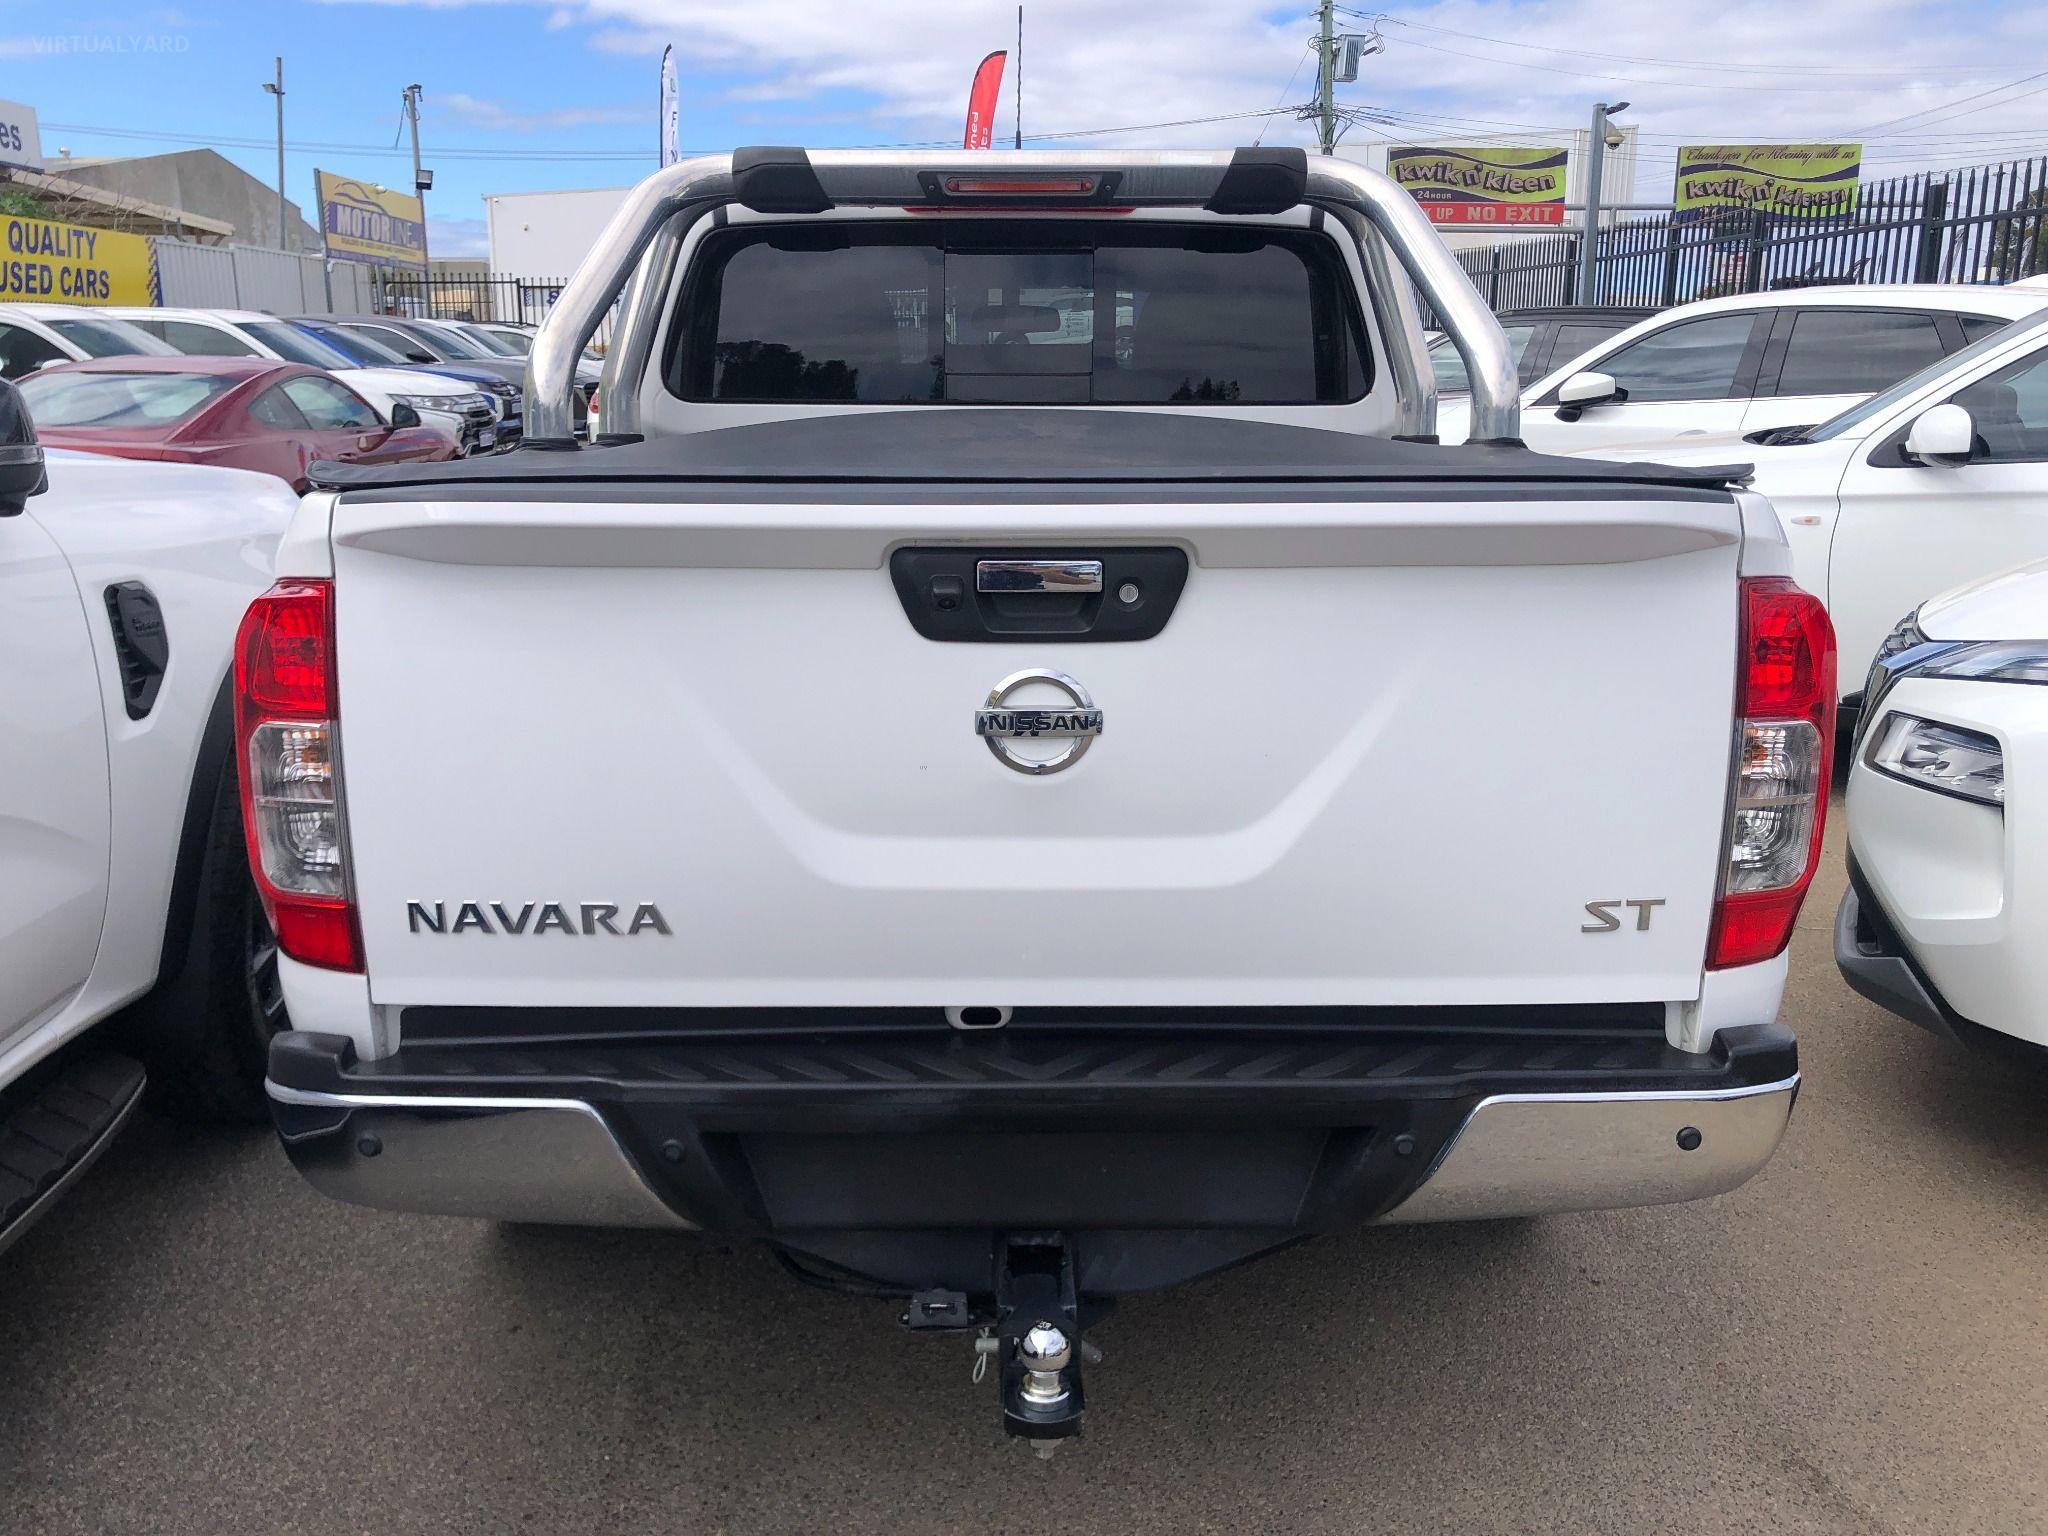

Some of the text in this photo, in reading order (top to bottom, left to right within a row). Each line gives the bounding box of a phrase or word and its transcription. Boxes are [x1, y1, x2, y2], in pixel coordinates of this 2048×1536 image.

[1816, 146, 1841, 159] with
[1395, 161, 1458, 186] kwik
[1483, 170, 1556, 195] kleen
[1686, 178, 1750, 201] kwik
[1437, 208, 1453, 219] UP
[1467, 207, 1496, 221] NO
[1506, 207, 1554, 222] EXIT
[8, 220, 97, 260] QUALITY
[0, 261, 110, 299] USED CARS
[988, 714, 1089, 731] NISSAN
[406, 899, 674, 935] NAVARA
[1581, 898, 1666, 932] ST
